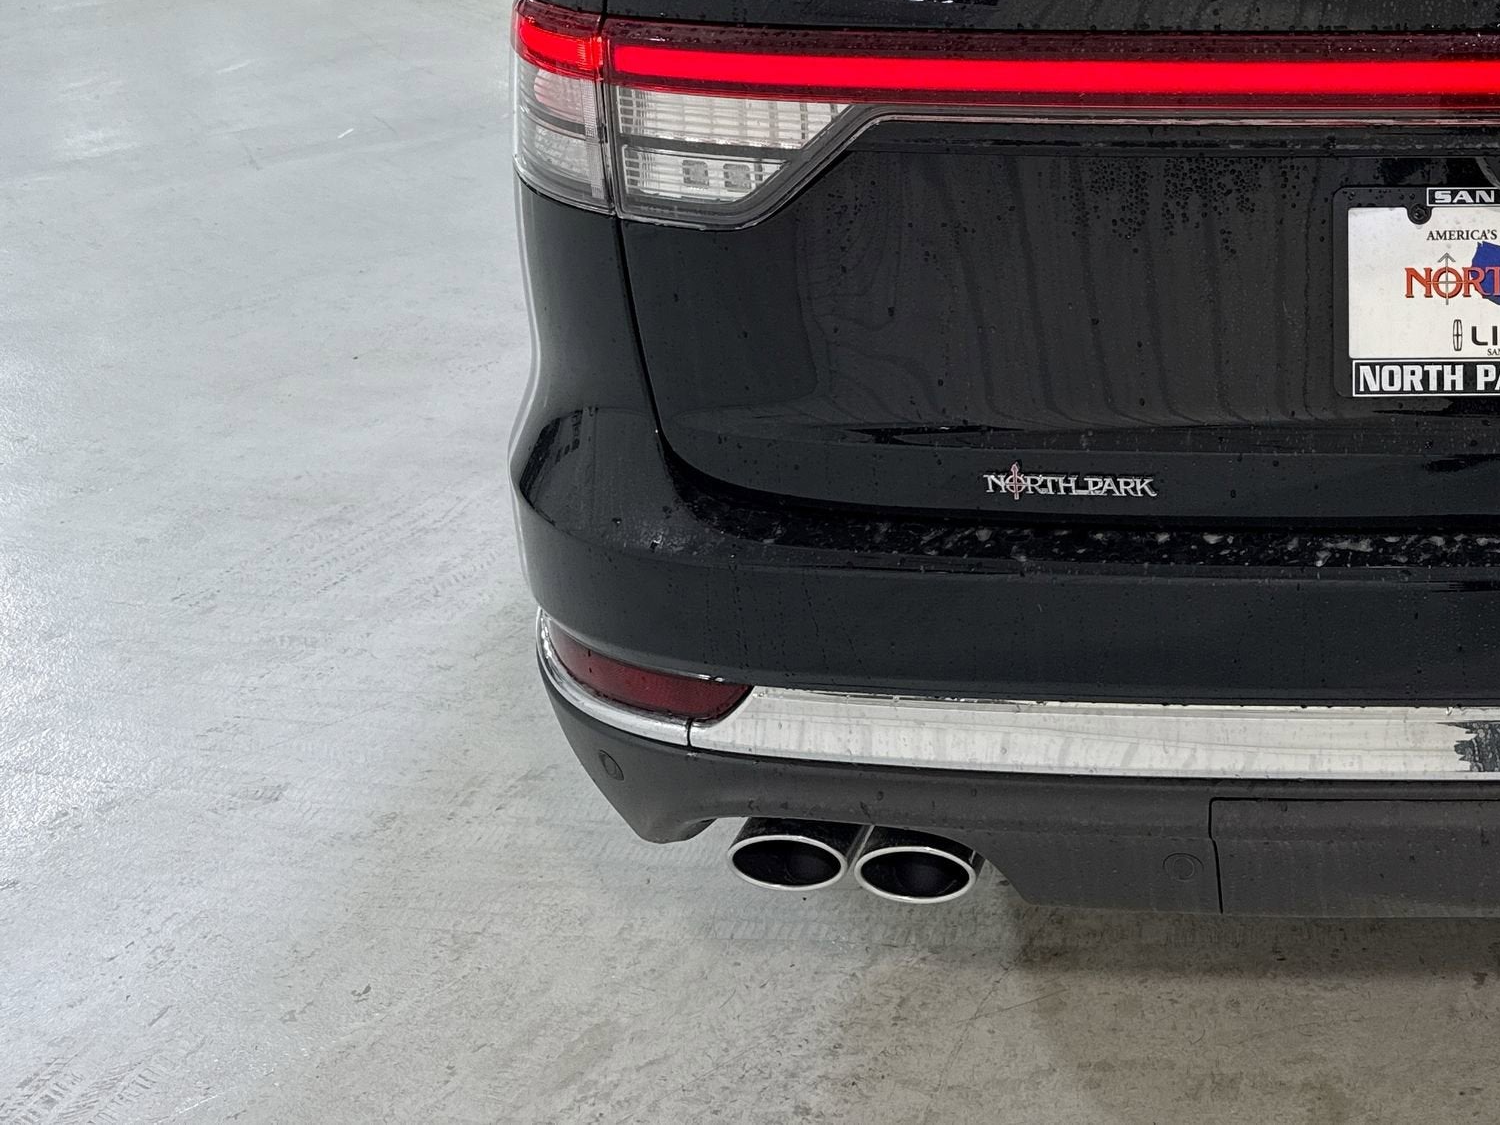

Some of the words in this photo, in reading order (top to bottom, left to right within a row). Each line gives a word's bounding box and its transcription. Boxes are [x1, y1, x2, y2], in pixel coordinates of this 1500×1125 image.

[1434, 190, 1495, 203] SAN
[1360, 365, 1464, 392] NORTH
[983, 473, 1078, 495] NORTH
[1082, 477, 1157, 497] PARK
